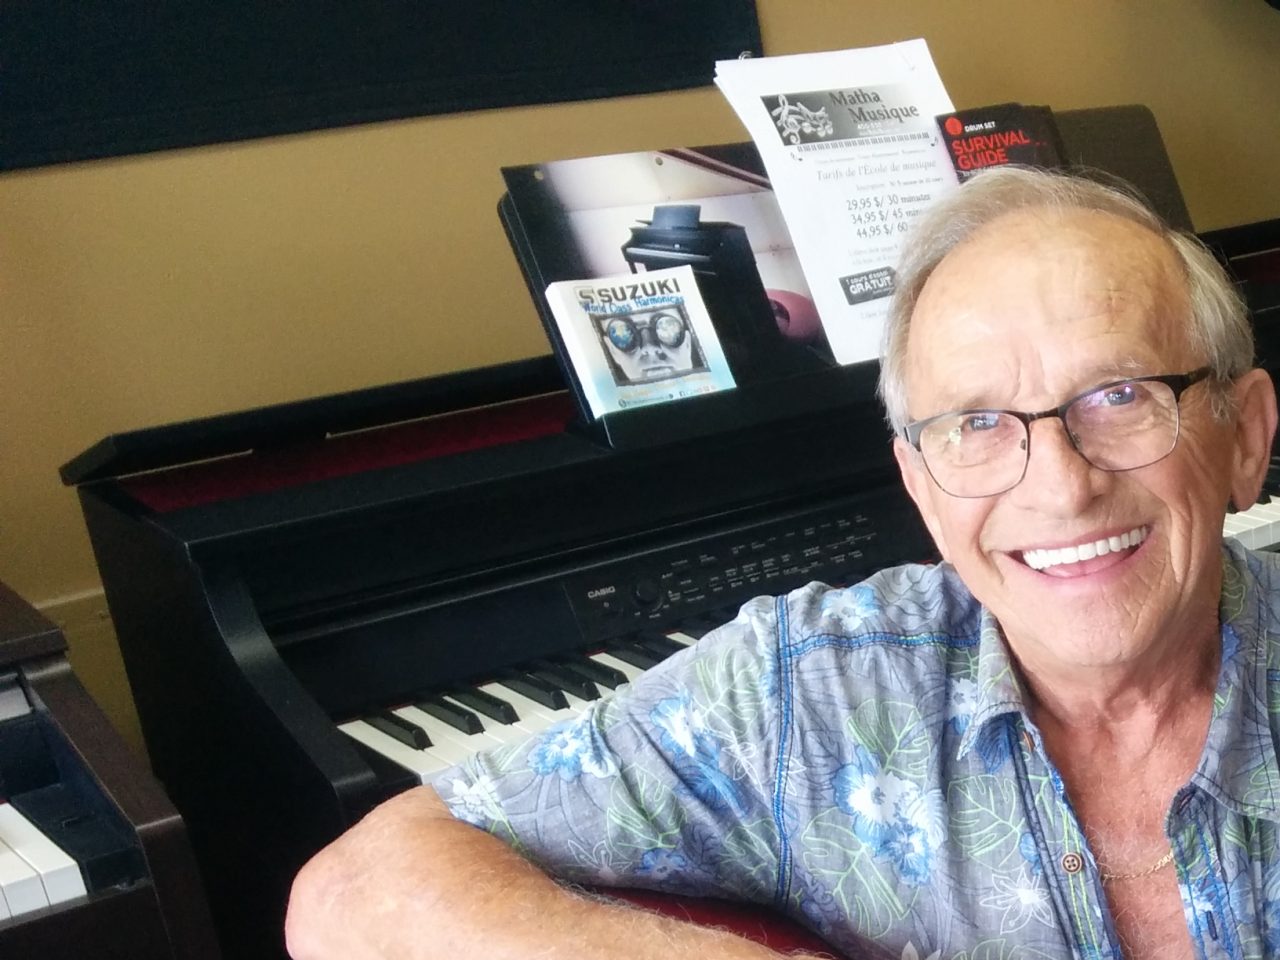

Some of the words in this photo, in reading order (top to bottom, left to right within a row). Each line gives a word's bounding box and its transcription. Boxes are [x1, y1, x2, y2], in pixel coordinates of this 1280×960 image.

[828, 89, 883, 106] Matha
[848, 104, 920, 124] Musique
[964, 124, 983, 133] DRUM
[984, 121, 996, 129] SET
[952, 130, 1031, 156] SURVIVAL
[958, 148, 1009, 170] GUIDE
[846, 197, 872, 211] 29,95
[887, 193, 899, 205] 30
[851, 211, 876, 224] 34,95
[892, 207, 903, 219] 45
[856, 224, 881, 239] 44,95
[897, 220, 909, 233] 60
[597, 278, 681, 303] SUZUKI
[849, 276, 892, 294] GRATUIT
[583, 301, 606, 313] World
[609, 300, 632, 314] Class
[634, 295, 684, 308] Harmonicas
[587, 586, 616, 599] CASIO
